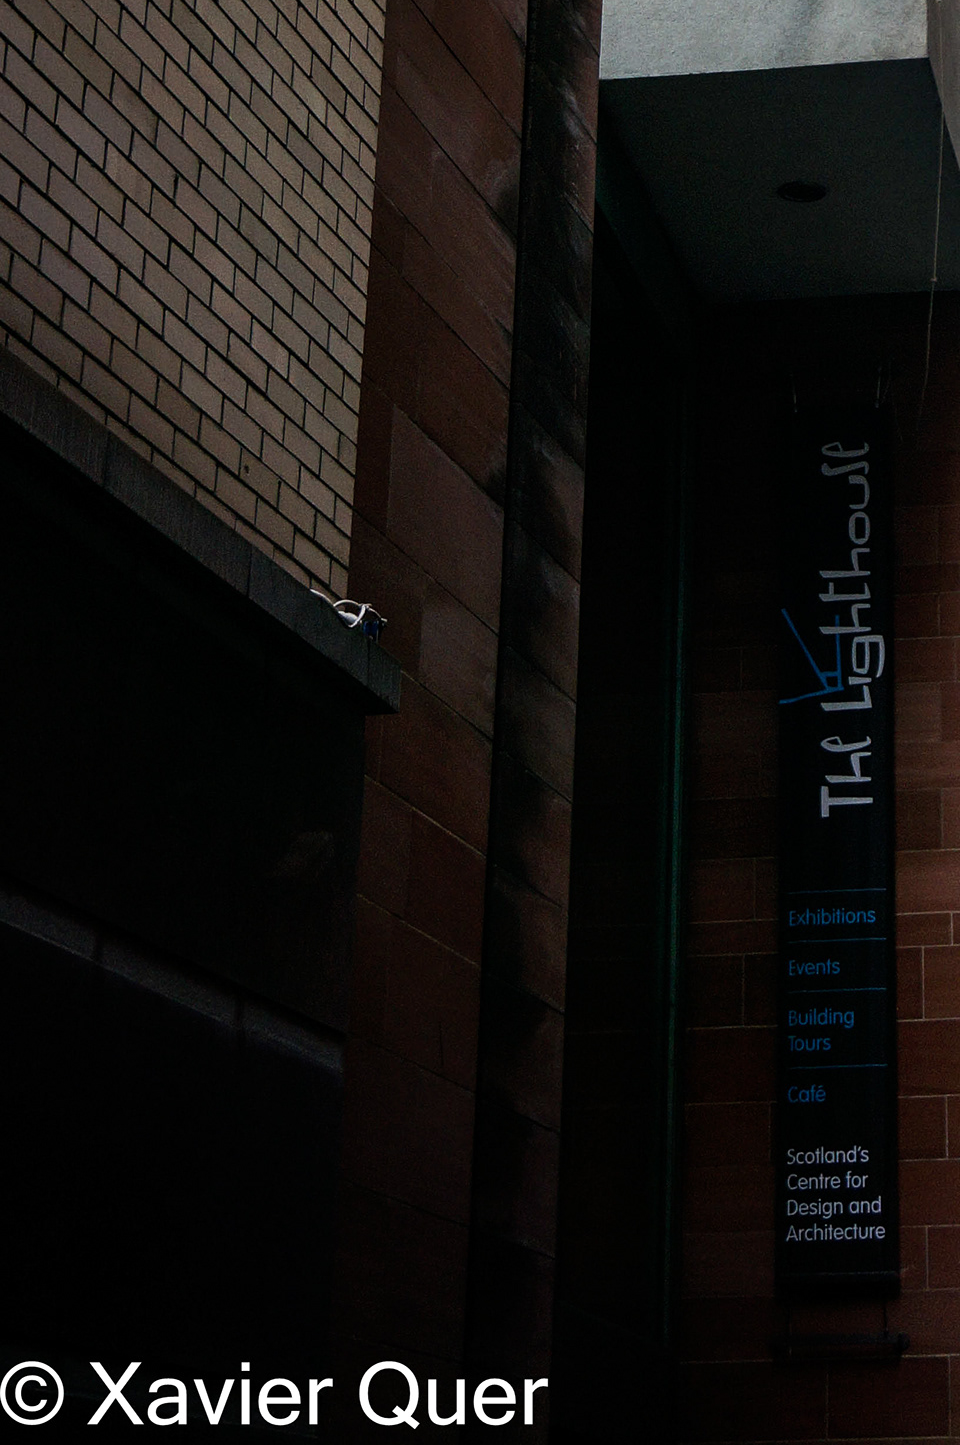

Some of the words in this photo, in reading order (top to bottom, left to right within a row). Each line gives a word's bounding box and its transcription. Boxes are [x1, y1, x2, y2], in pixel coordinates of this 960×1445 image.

[820, 441, 886, 713] Lighthouse
[820, 735, 874, 819] The
[788, 908, 877, 927] Exhibitions
[788, 958, 841, 977] Events
[787, 1007, 856, 1030] Building
[788, 1035, 832, 1052] Tours
[787, 1085, 827, 1104] Café
[786, 1145, 870, 1167] Scotland's
[786, 1173, 842, 1192] Centre
[845, 1170, 869, 1190] for
[786, 1198, 845, 1220] Design
[848, 1195, 883, 1216] and
[785, 1222, 887, 1243] Architecture
